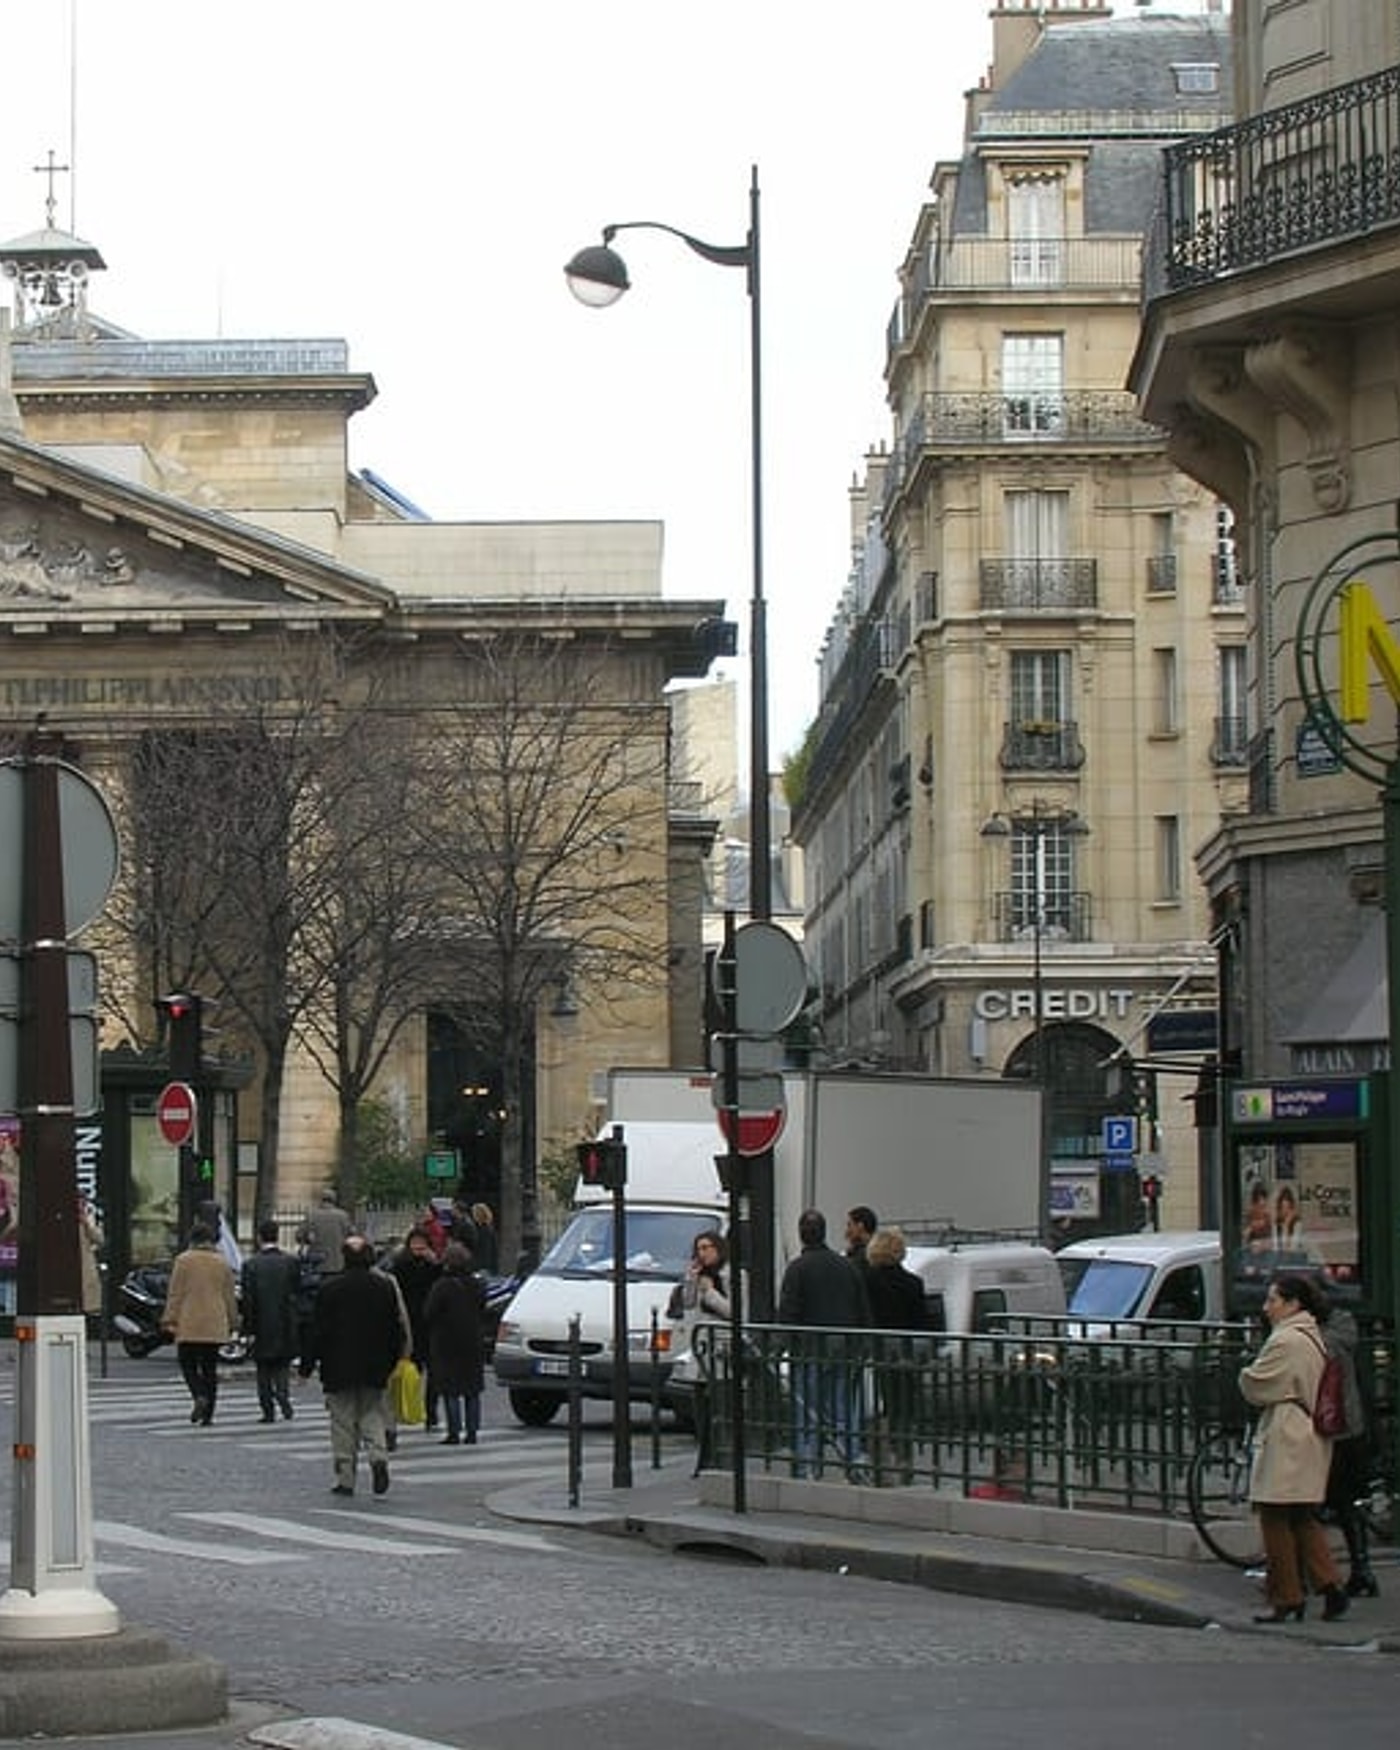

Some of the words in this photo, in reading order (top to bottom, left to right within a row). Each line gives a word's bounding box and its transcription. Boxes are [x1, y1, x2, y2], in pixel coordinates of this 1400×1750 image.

[976, 988, 1134, 1019] CREDIT
[1297, 1048, 1355, 1073] ALAIN
[1112, 1124, 1127, 1147] P
